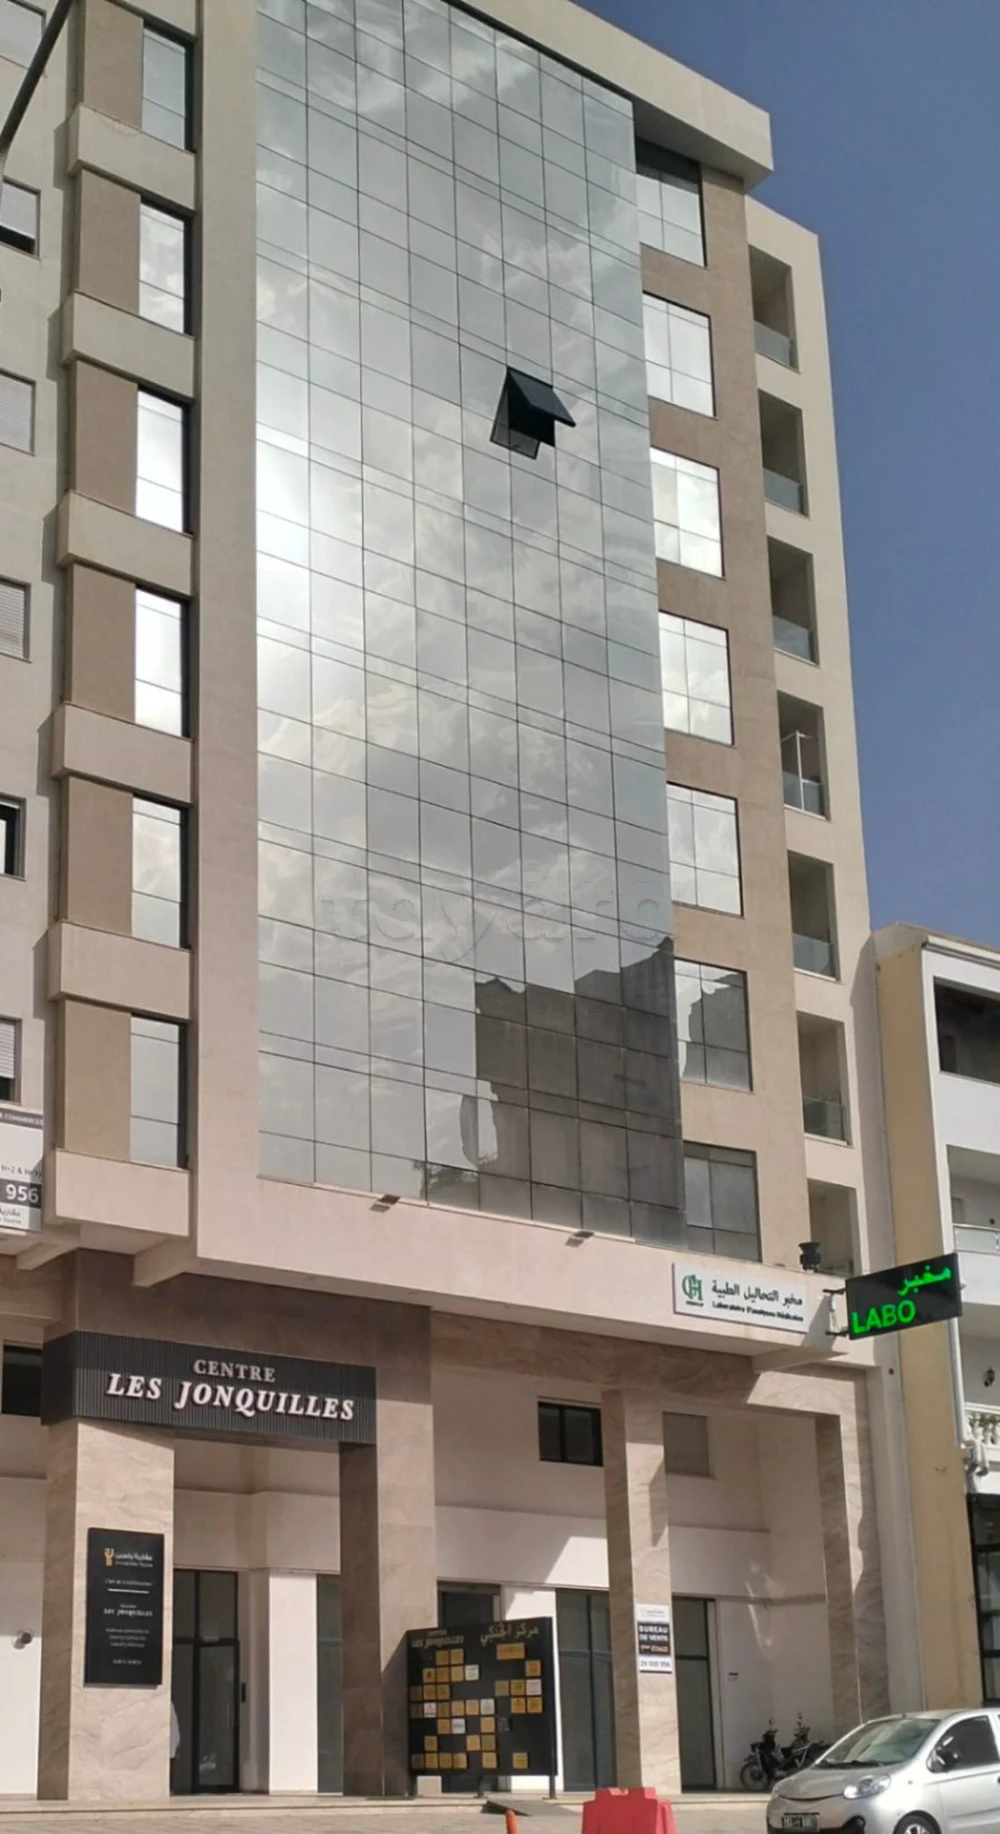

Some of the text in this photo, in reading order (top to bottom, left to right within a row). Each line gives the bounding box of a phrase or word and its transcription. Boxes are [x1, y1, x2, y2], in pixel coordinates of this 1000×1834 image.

[5, 1183, 39, 1204] 956
[711, 1280, 803, 1308] مخبر التحاليل الطبية
[897, 1265, 952, 1297] مخبر
[851, 1299, 916, 1334] LABO
[192, 1359, 276, 1383] CENTRE
[106, 1373, 355, 1420] LES JONQUILLES
[639, 1625, 669, 1634] BUREAU
